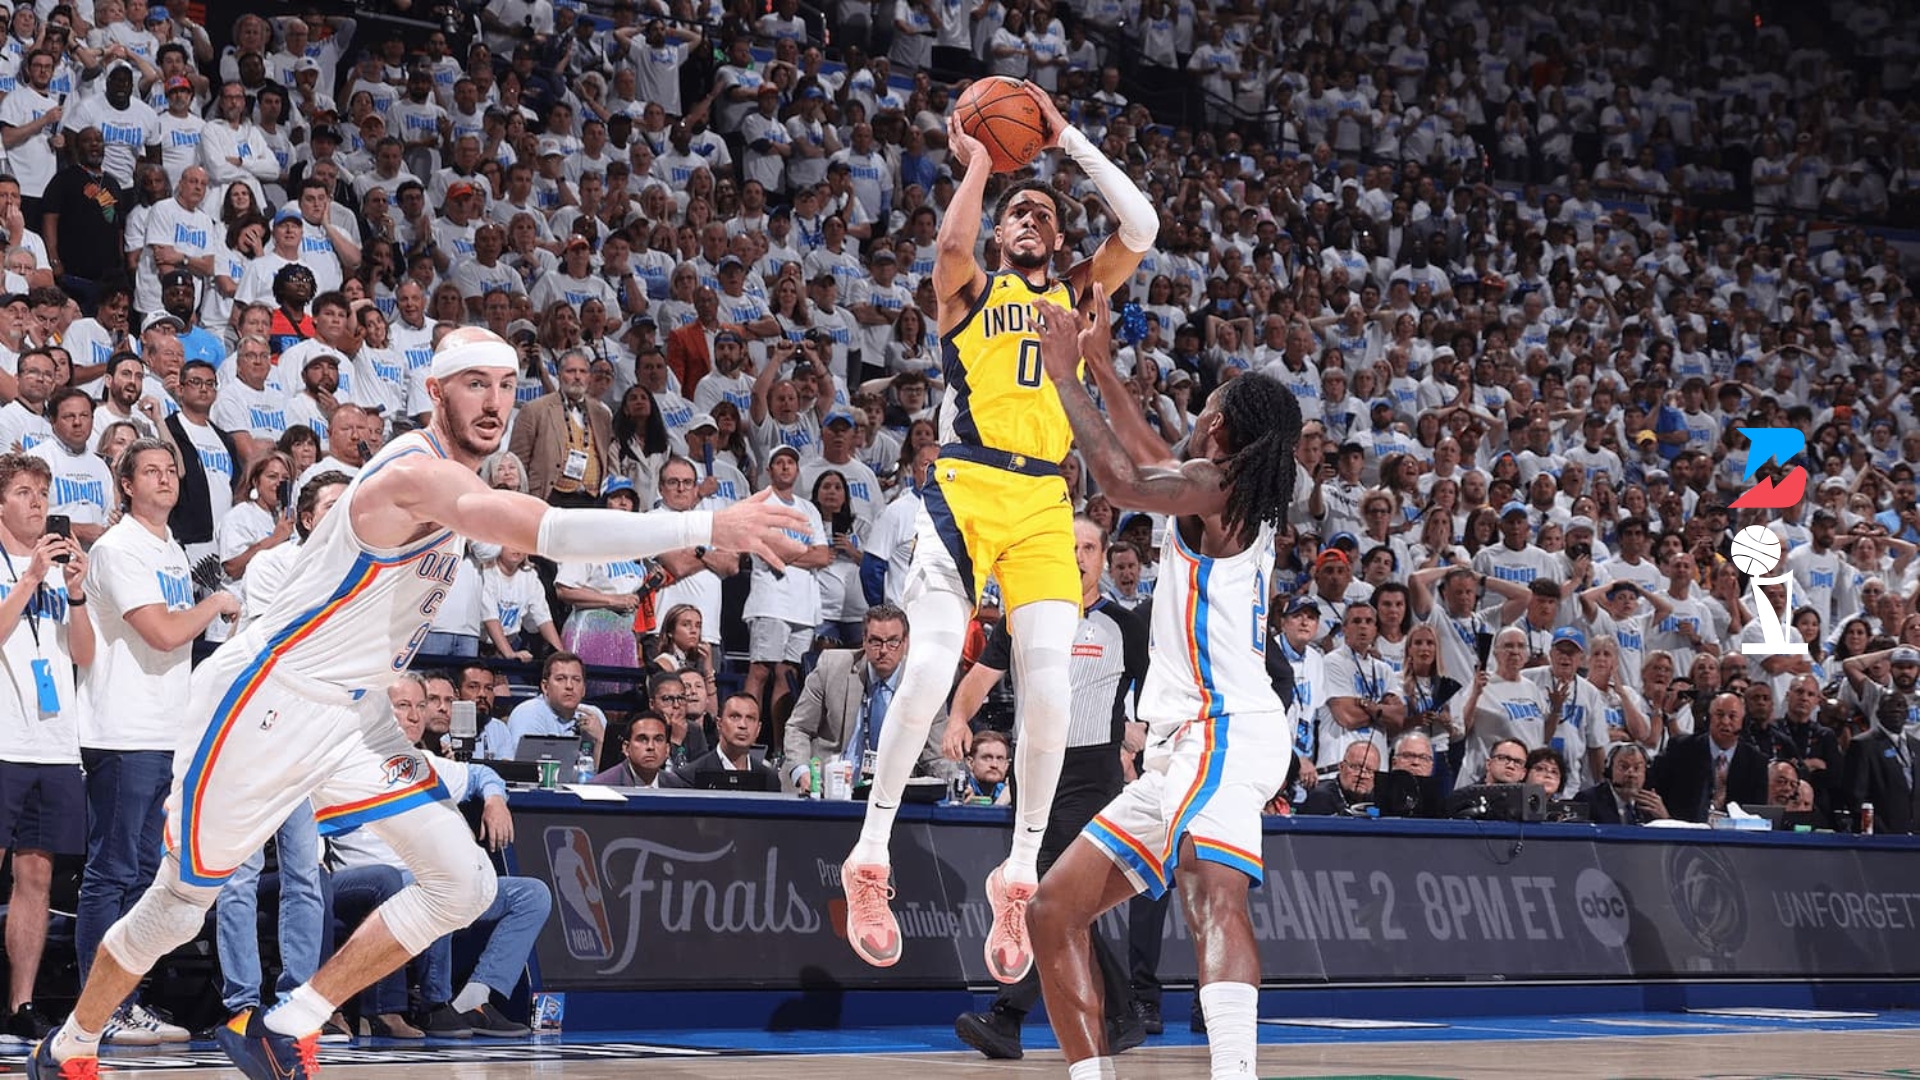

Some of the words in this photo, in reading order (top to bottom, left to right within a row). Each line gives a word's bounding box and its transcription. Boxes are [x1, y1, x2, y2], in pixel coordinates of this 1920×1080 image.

[982, 302, 1048, 338] INDI
[1016, 338, 1043, 388] 0
[596, 837, 821, 975] Finals
[896, 902, 960, 938] uTube
[1250, 870, 1371, 941] GAME
[1369, 870, 1408, 941] 2
[1416, 871, 1516, 941] 8PM
[1511, 876, 1565, 940] ET
[1580, 892, 1625, 919] abc
[571, 928, 597, 951] NBA
